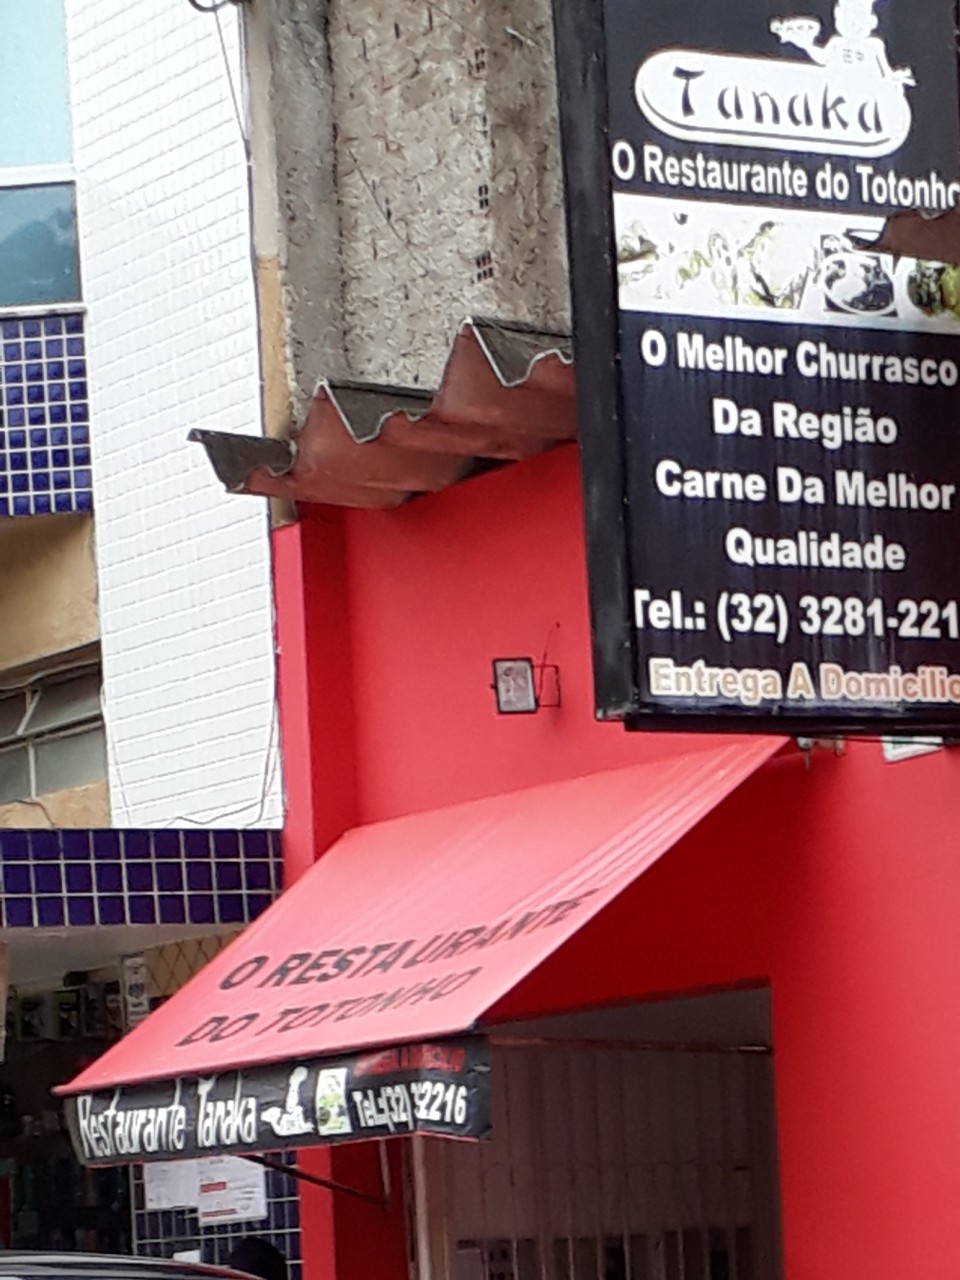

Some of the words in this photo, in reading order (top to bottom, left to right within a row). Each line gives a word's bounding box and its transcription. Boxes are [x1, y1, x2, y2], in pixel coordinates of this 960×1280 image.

[672, 66, 884, 135] Tanaka
[612, 141, 635, 181] O
[643, 145, 808, 199] Restaurante
[815, 162, 849, 200] do
[641, 329, 667, 367] O
[677, 332, 788, 375] Melhor
[796, 340, 958, 387] Churrasco
[713, 398, 763, 437] Da
[773, 401, 898, 450] Região
[655, 459, 767, 501] Carne
[777, 466, 825, 505] Da
[835, 470, 956, 511] Melhor
[726, 527, 906, 571] Qualidade
[634, 589, 706, 630] Tel.:
[717, 592, 789, 643] (32)
[649, 658, 782, 706] Entrega
[787, 662, 816, 698] A
[219, 955, 267, 991] O
[257, 888, 600, 989] RESTAURANTE
[175, 1013, 260, 1047] DO
[254, 967, 484, 1036] TOTONHO
[77, 1079, 186, 1157] Restaurante
[197, 1074, 257, 1147] Tanaka
